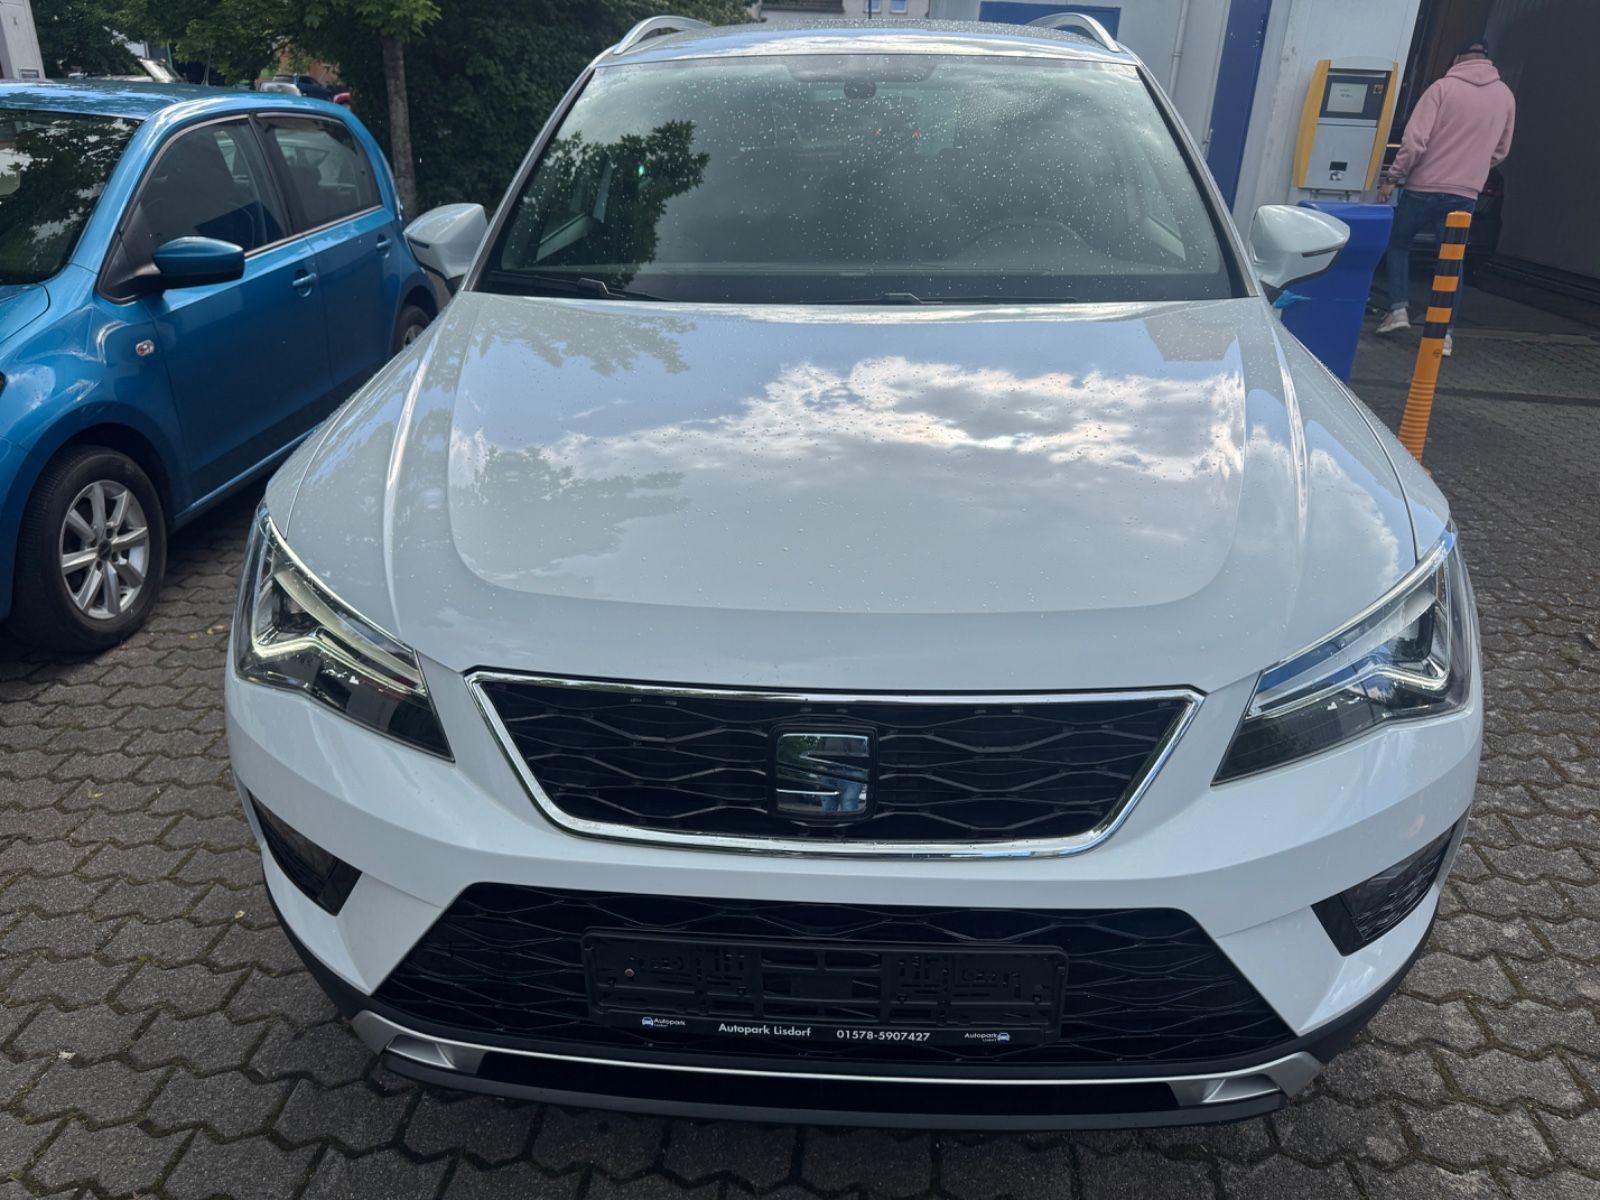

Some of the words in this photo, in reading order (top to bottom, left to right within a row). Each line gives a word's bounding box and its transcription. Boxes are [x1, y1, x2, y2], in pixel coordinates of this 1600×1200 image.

[653, 1018, 686, 1026] Autopark
[718, 1023, 770, 1035] Autopark
[773, 1026, 811, 1037] Lisdorf
[836, 1029, 931, 1042] 01578-5907427
